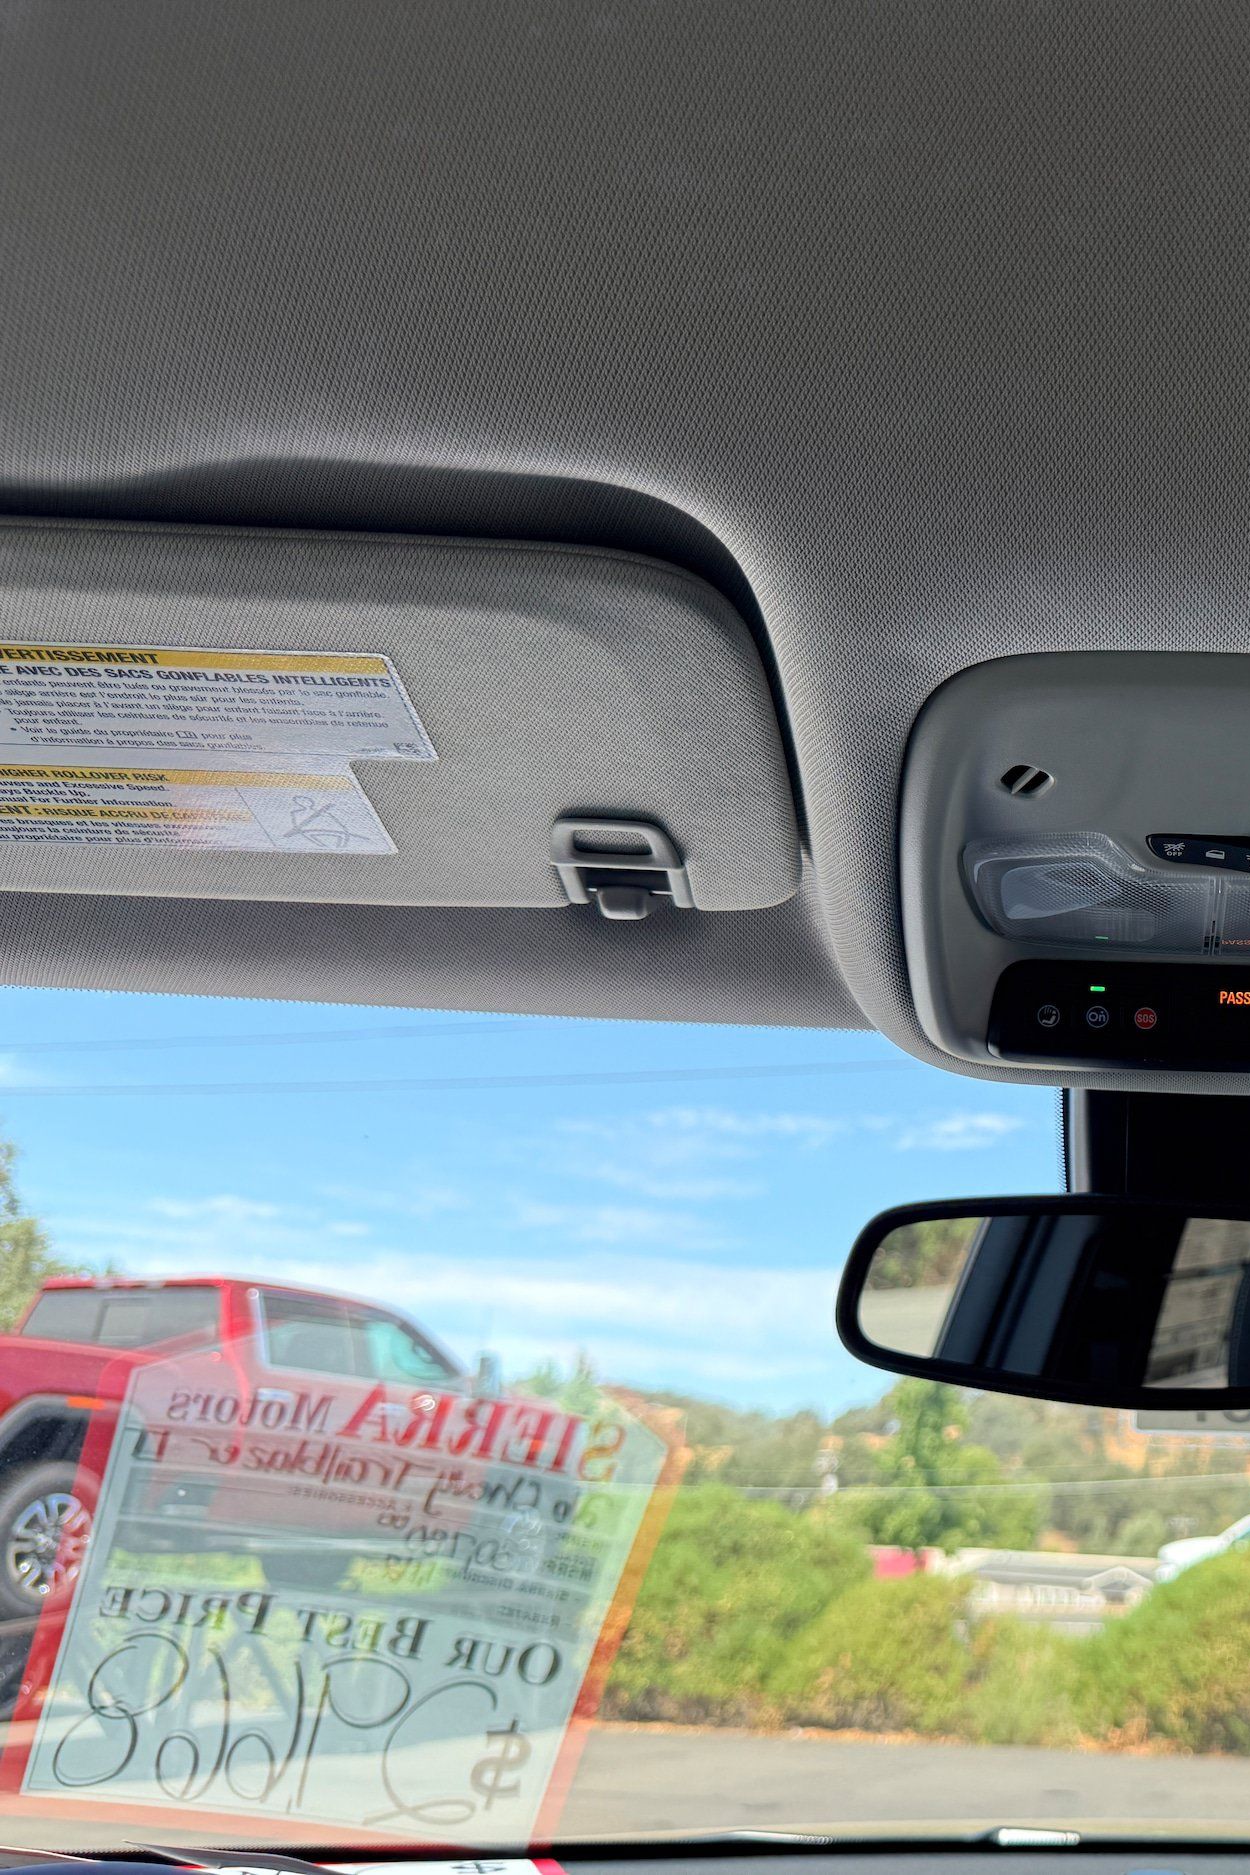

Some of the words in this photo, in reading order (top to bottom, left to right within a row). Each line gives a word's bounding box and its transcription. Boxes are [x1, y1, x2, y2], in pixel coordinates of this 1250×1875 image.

[16, 666, 62, 677] AVEC
[64, 667, 102, 678] DES
[104, 668, 153, 680] SACS
[156, 670, 270, 683] GONFLABLES
[272, 674, 391, 687] INTELLIGENTS
[50, 771, 131, 780] ROLLOVER
[62, 782, 124, 790] Excessive
[126, 784, 170, 792] Speed.
[42, 808, 98, 817] RISQUE
[100, 810, 148, 818] ACCRU
[1137, 1014, 1155, 1023] SOS
